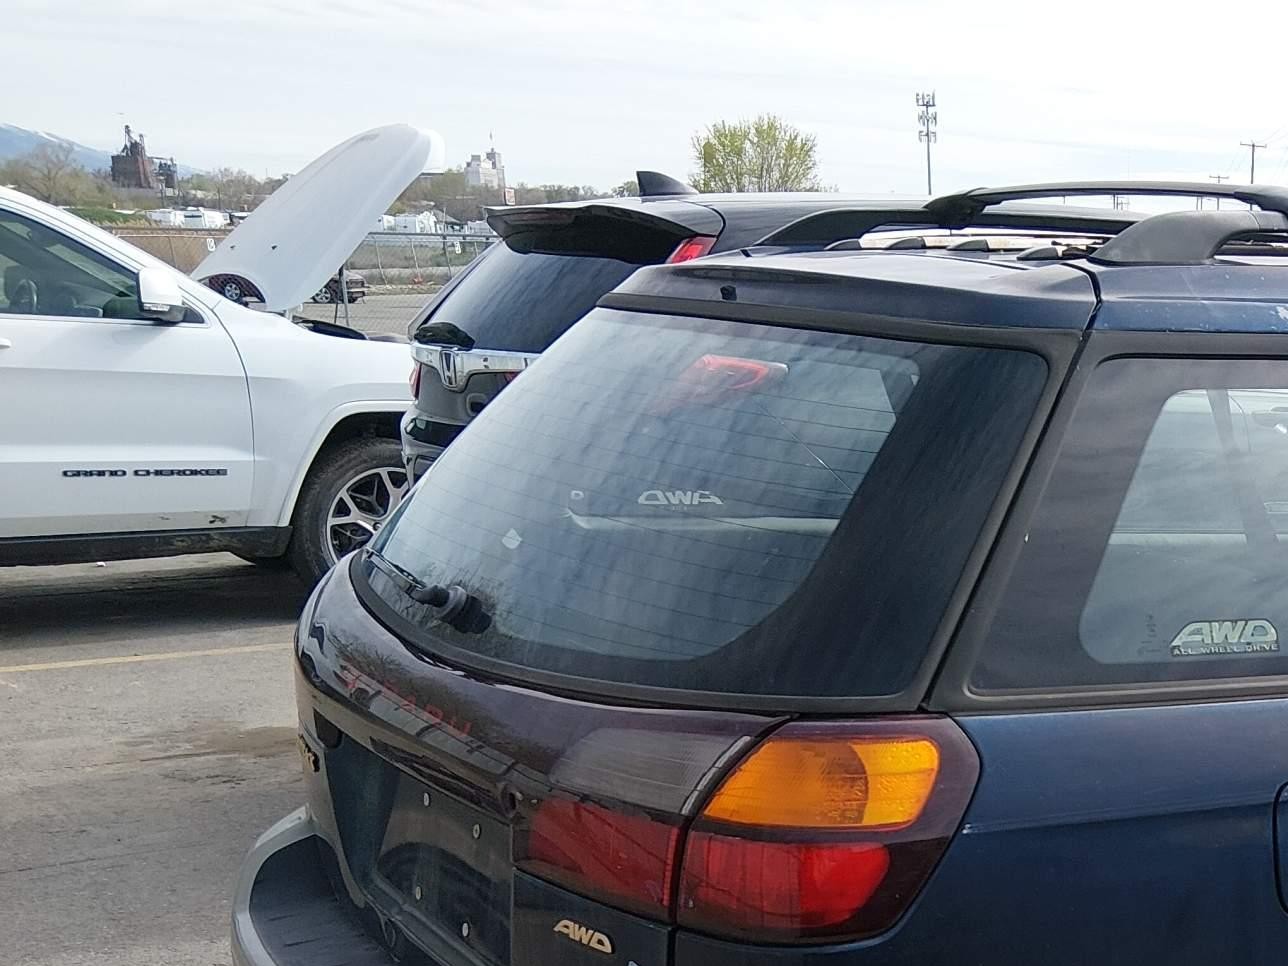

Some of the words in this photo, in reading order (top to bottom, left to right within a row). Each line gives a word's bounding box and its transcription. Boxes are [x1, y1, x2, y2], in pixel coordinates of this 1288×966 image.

[62, 469, 127, 477] GRAND
[133, 468, 228, 477] CHEROKEE
[1169, 619, 1278, 646] AWD
[553, 919, 613, 954] AWD
